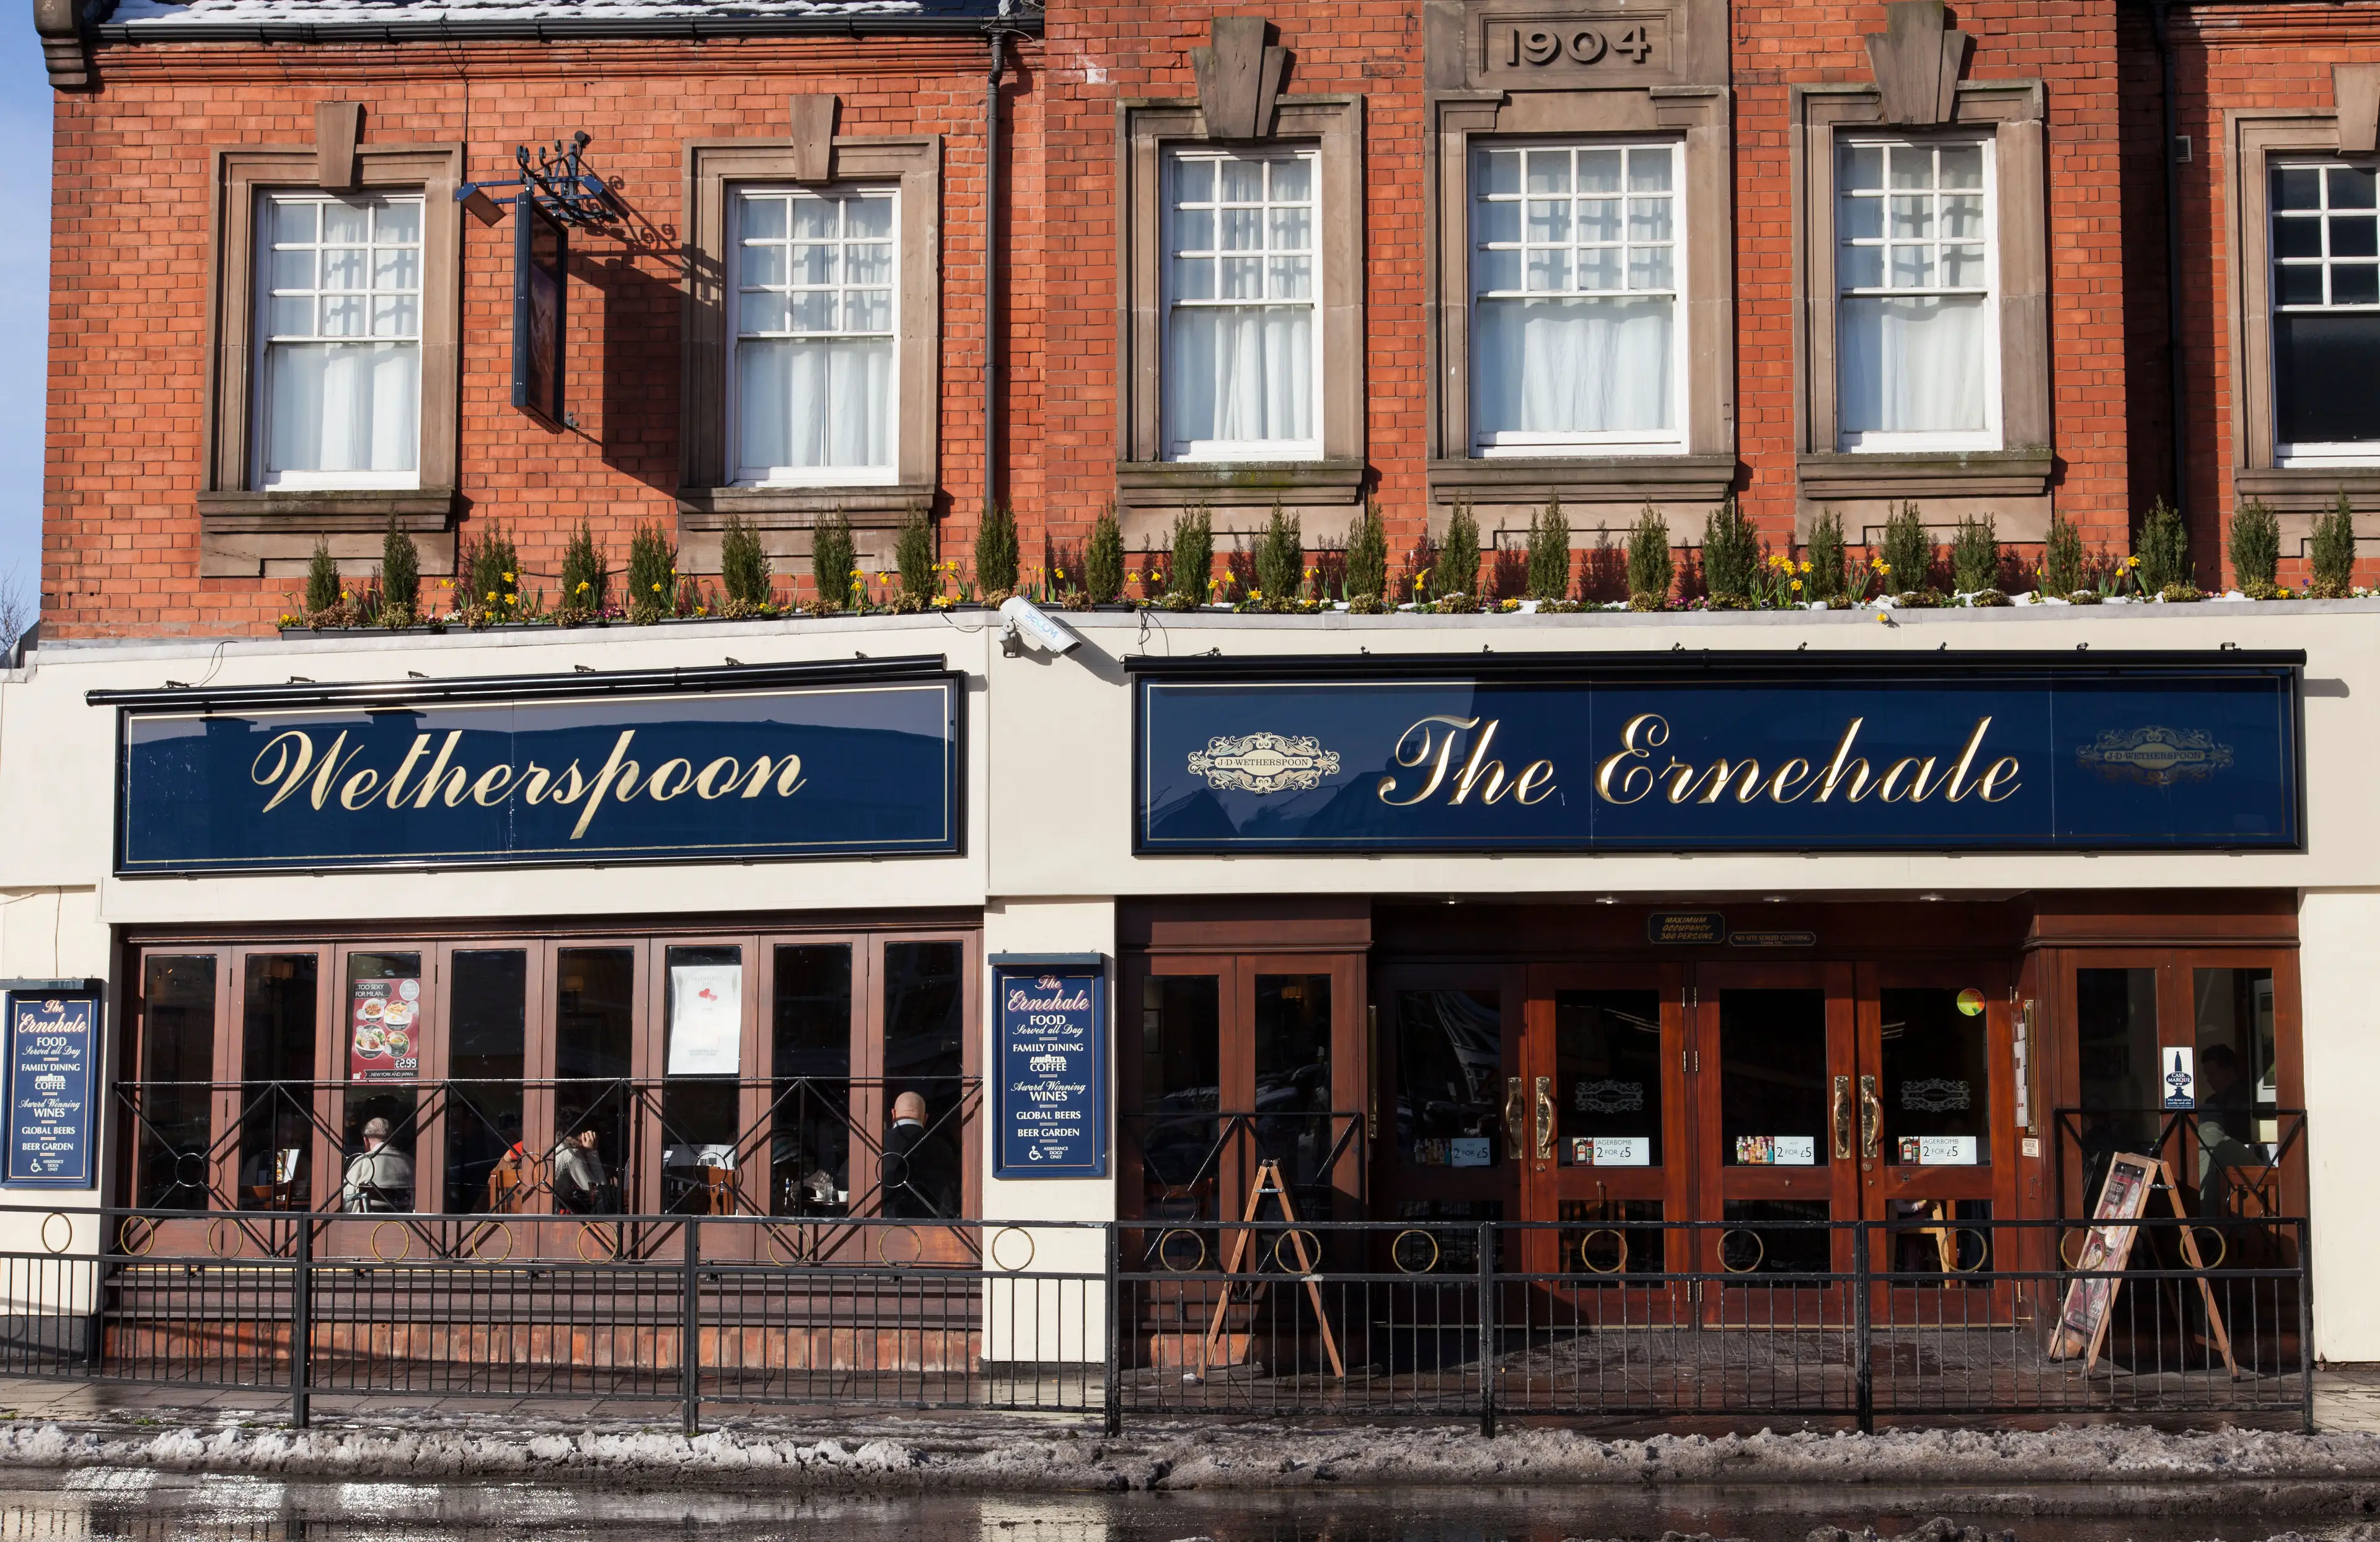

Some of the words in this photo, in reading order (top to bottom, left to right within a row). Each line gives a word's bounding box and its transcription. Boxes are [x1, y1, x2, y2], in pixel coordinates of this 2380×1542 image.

[1505, 25, 1651, 66] 1904
[1377, 713, 1558, 806] The
[1596, 713, 2022, 806] Ernehale
[252, 729, 807, 840] Wetherspoon
[1660, 932, 1677, 940] 300
[1035, 975, 1061, 990] The
[1008, 989, 1090, 1013] Ernehale
[42, 1000, 64, 1013] The
[19, 1013, 86, 1034] Ernehale
[1030, 1015, 1066, 1025] FOOD
[1013, 1024, 1046, 1035] Served
[1047, 1024, 1061, 1034] all
[1062, 1024, 1083, 1038] Day
[37, 1037, 66, 1047] FOOD
[22, 1046, 50, 1055] Served
[50, 1046, 63, 1055] all
[64, 1046, 81, 1059] Day
[1013, 1044, 1046, 1052] FAMILY
[1047, 1043, 1084, 1052] DINING
[395, 1059, 416, 1068] £2.99
[1029, 1054, 1067, 1063] LAVAZZA
[22, 1064, 49, 1072] FAMILY
[1029, 1063, 1067, 1072] COFFEE
[35, 1073, 66, 1082] LAVAZZA
[1011, 1081, 1044, 1092] Award
[1045, 1080, 1086, 1095] Winning
[1030, 1091, 1068, 1101] WINES
[18, 1099, 46, 1108] Award
[46, 1098, 81, 1111] Winning
[33, 1108, 65, 1117] WINES
[1016, 1111, 1052, 1120] GLOBAL
[1055, 1111, 1081, 1119] BEERS
[1018, 1129, 1039, 1137] BEER
[1041, 1128, 1080, 1137] GARDEN
[1453, 1148, 1460, 1158] 2
[1477, 1147, 1488, 1158] £5
[1597, 1147, 1603, 1157] 2
[1620, 1147, 1631, 1157] £5
[1776, 1147, 1783, 1157] 2
[1800, 1147, 1812, 1157] £5
[1923, 1146, 1930, 1156] 2
[1947, 1146, 1958, 1156] £5
